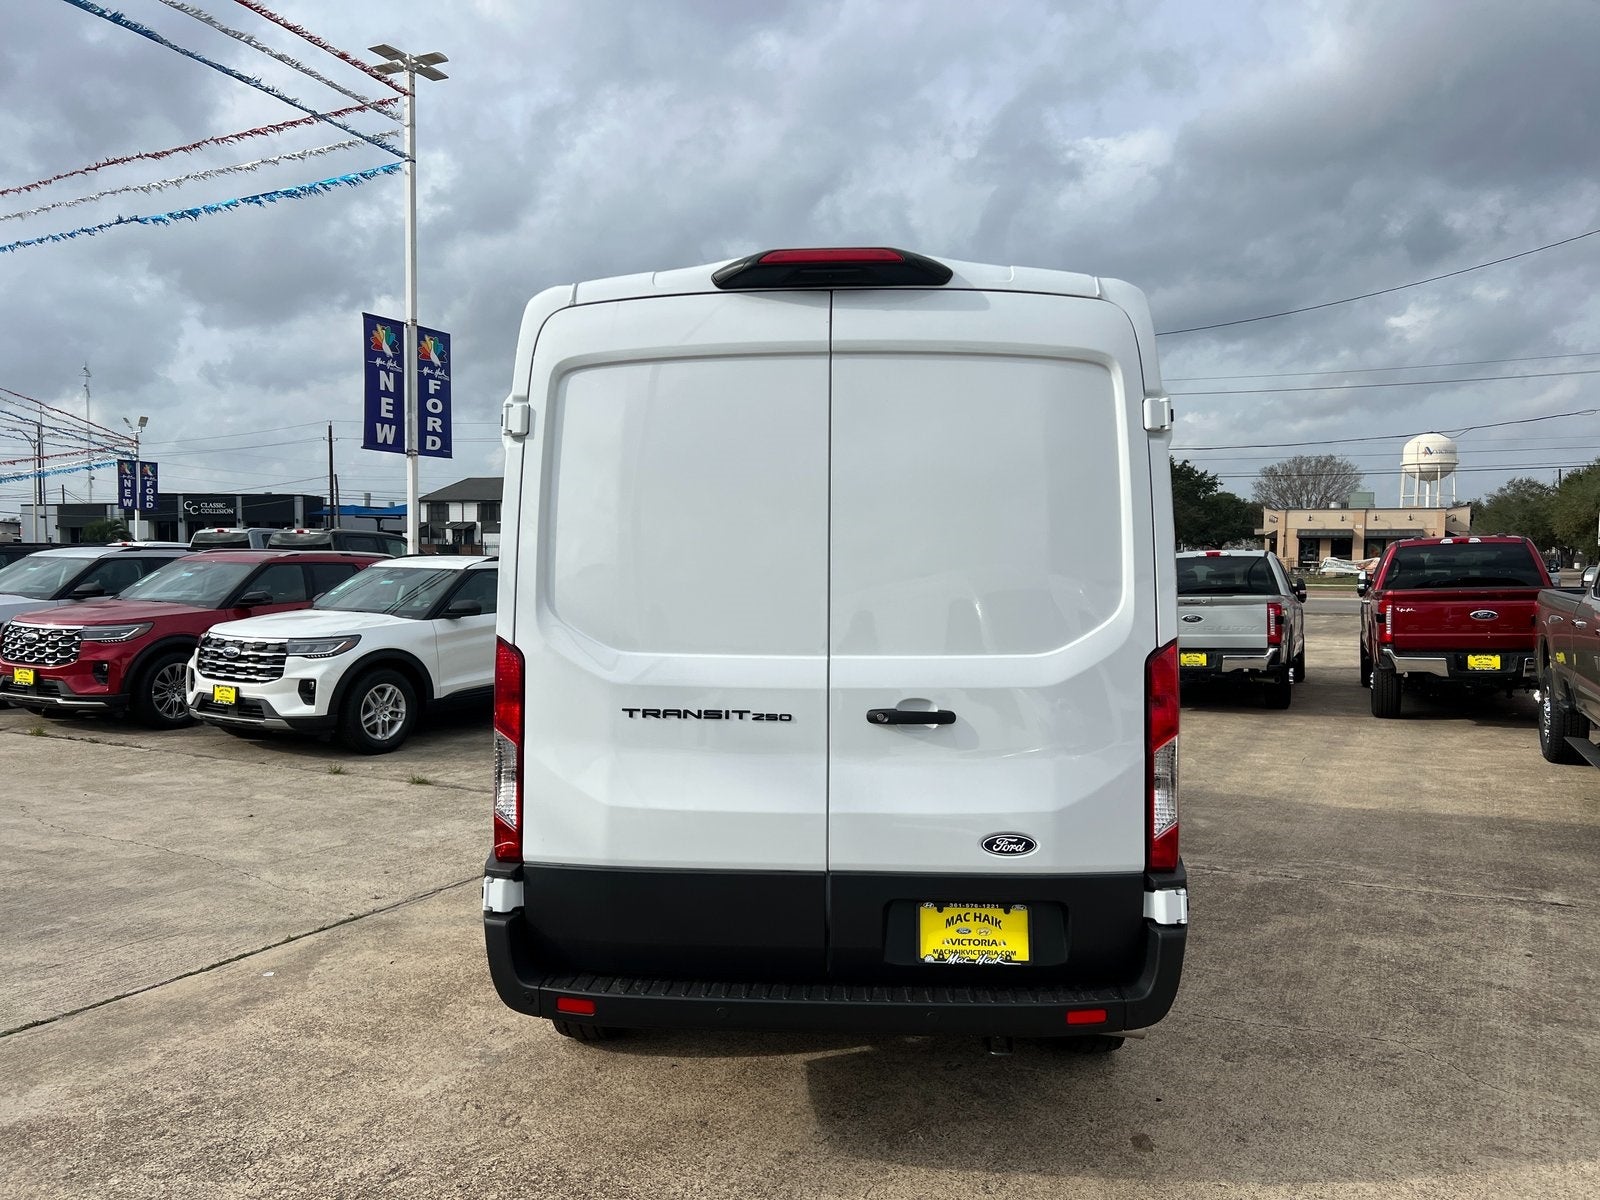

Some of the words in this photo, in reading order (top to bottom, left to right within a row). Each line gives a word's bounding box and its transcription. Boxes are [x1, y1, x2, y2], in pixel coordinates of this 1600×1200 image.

[376, 370, 396, 445] NEW
[426, 379, 443, 451] FORD
[122, 479, 133, 507] NEW
[146, 481, 154, 508] FORD
[622, 708, 751, 719] TRANSIT
[752, 713, 792, 721] 250
[992, 838, 1025, 852] Ford
[945, 912, 971, 929] MAC
[973, 912, 1002, 930] HAIK
[949, 938, 998, 947] VICTORIA
[945, 953, 970, 965] Mac
[975, 953, 1003, 965] Haik
